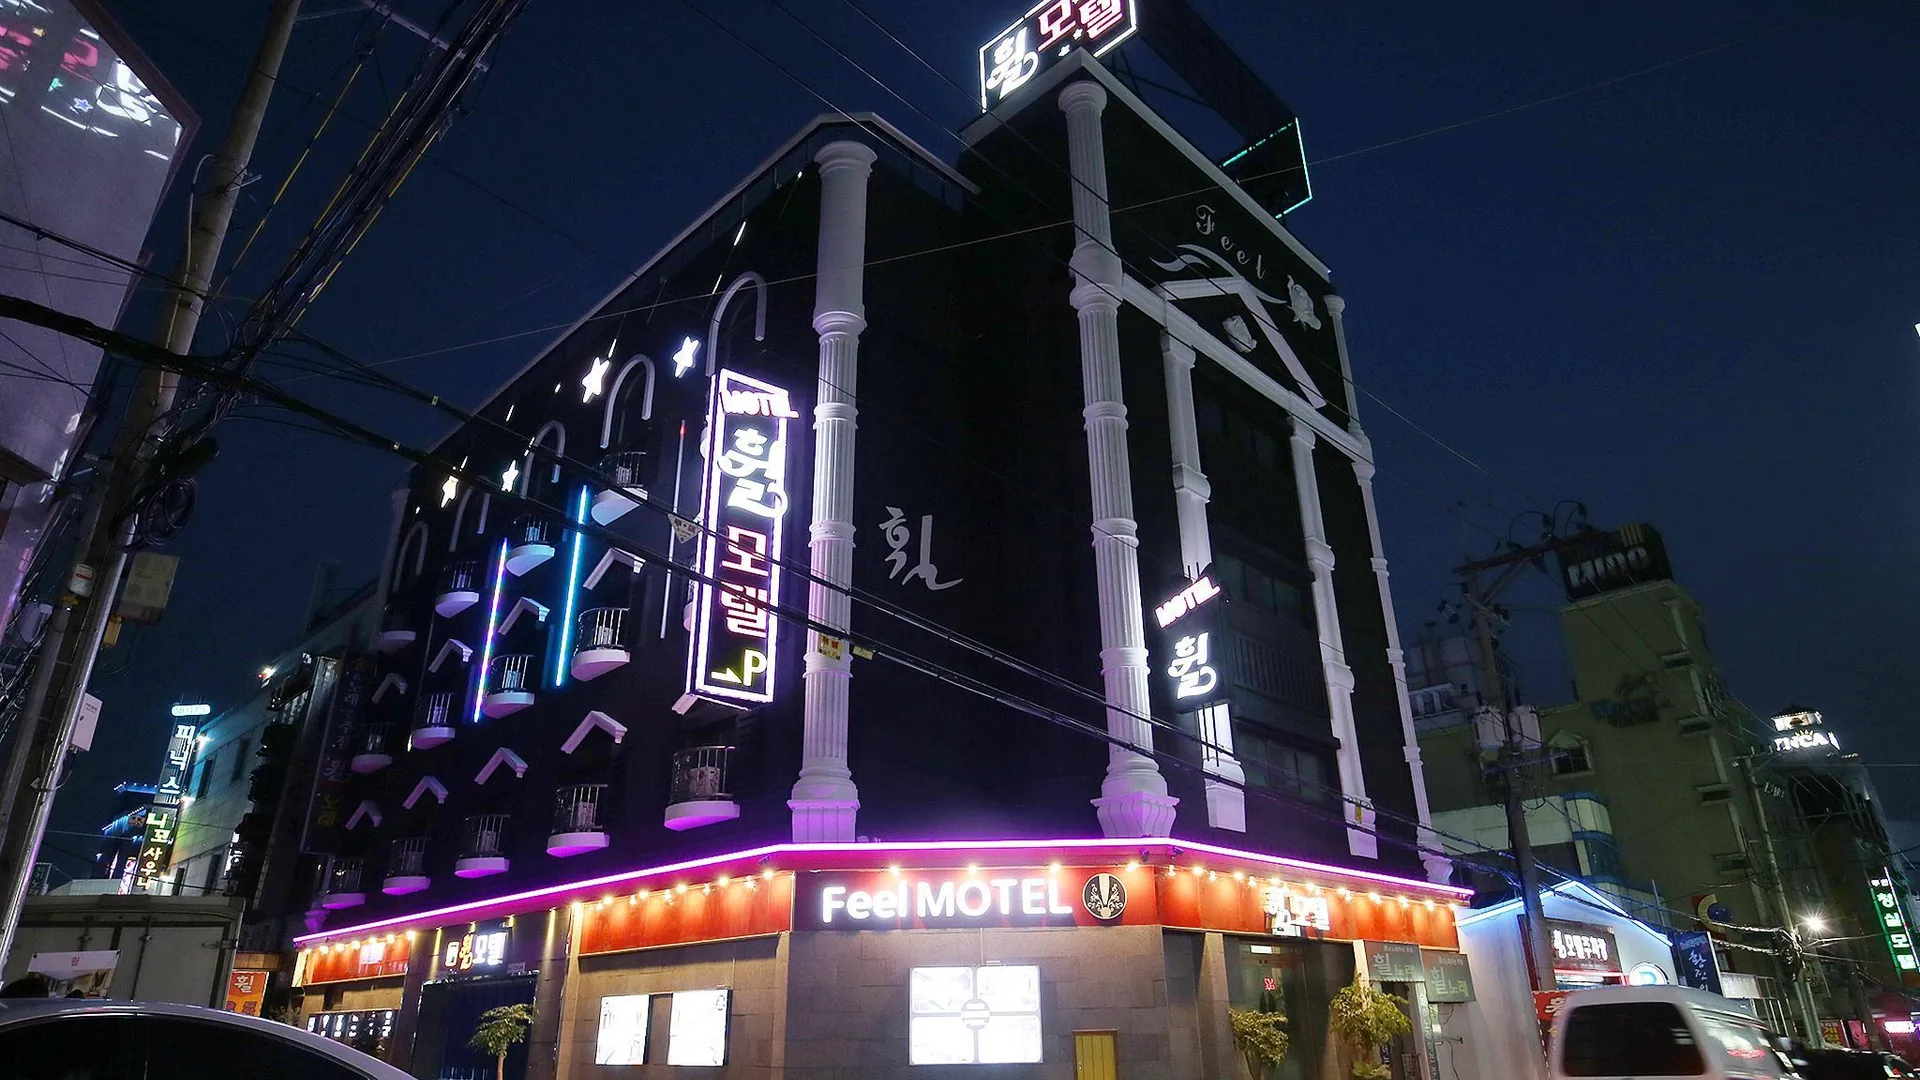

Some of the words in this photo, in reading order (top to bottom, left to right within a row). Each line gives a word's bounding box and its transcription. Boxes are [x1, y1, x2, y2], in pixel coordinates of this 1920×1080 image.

[1196, 205, 1266, 280] Feel
[719, 389, 800, 419] MOTEL
[1154, 575, 1221, 629] MOTEL
[742, 648, 768, 687] P
[136, 846, 164, 892] 사우나
[821, 879, 908, 923] Feel
[915, 877, 1074, 918] MOTEL
